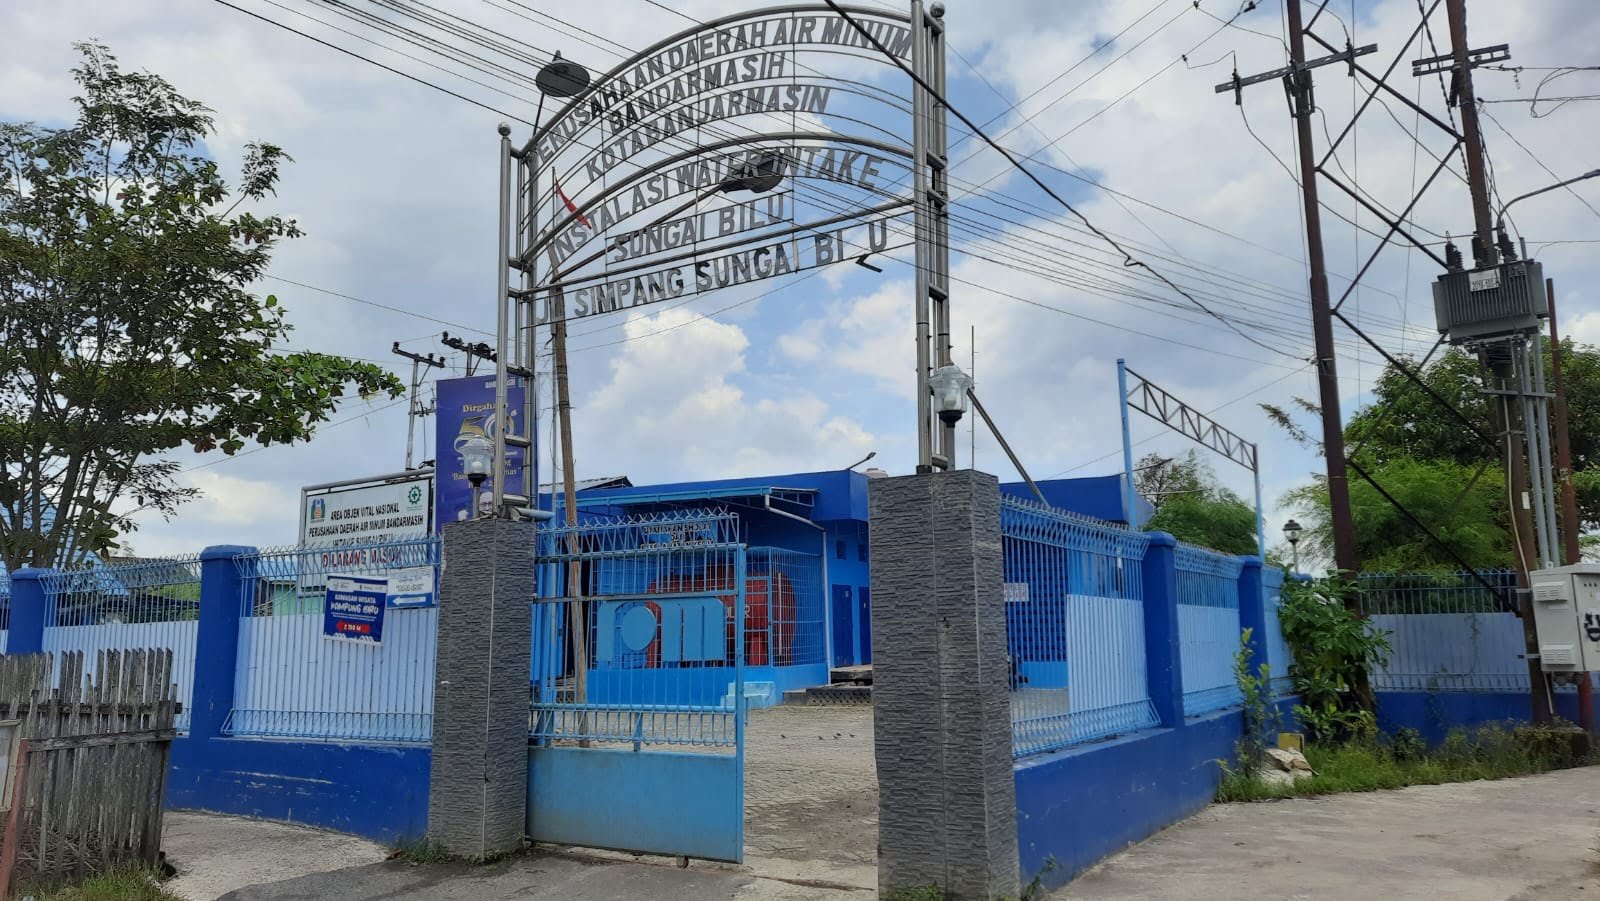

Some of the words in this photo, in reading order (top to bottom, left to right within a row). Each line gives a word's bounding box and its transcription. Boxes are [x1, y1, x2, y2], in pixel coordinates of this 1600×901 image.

[668, 20, 767, 71] DAERAH
[772, 16, 817, 45] AIR
[821, 16, 912, 58] MINUM
[609, 52, 786, 135] BANDARMASIH
[676, 148, 759, 194] WATER
[771, 147, 884, 190] INTAKE
[614, 214, 706, 262] SUNGAI
[719, 193, 784, 237] BILU
[574, 268, 684, 317] SIMPANG
[695, 240, 799, 292] SUNGAI
[308, 525, 339, 538] PERUSAHAAN
[339, 522, 360, 534] DAERAH
[360, 521, 369, 532] AIR
[369, 519, 385, 530] MINUM
[386, 515, 424, 529] BANDARMASIH
[331, 511, 343, 521] AREA
[343, 508, 360, 520] OBJEK
[361, 505, 375, 517] VITAL
[375, 502, 400, 514] NASIONAL
